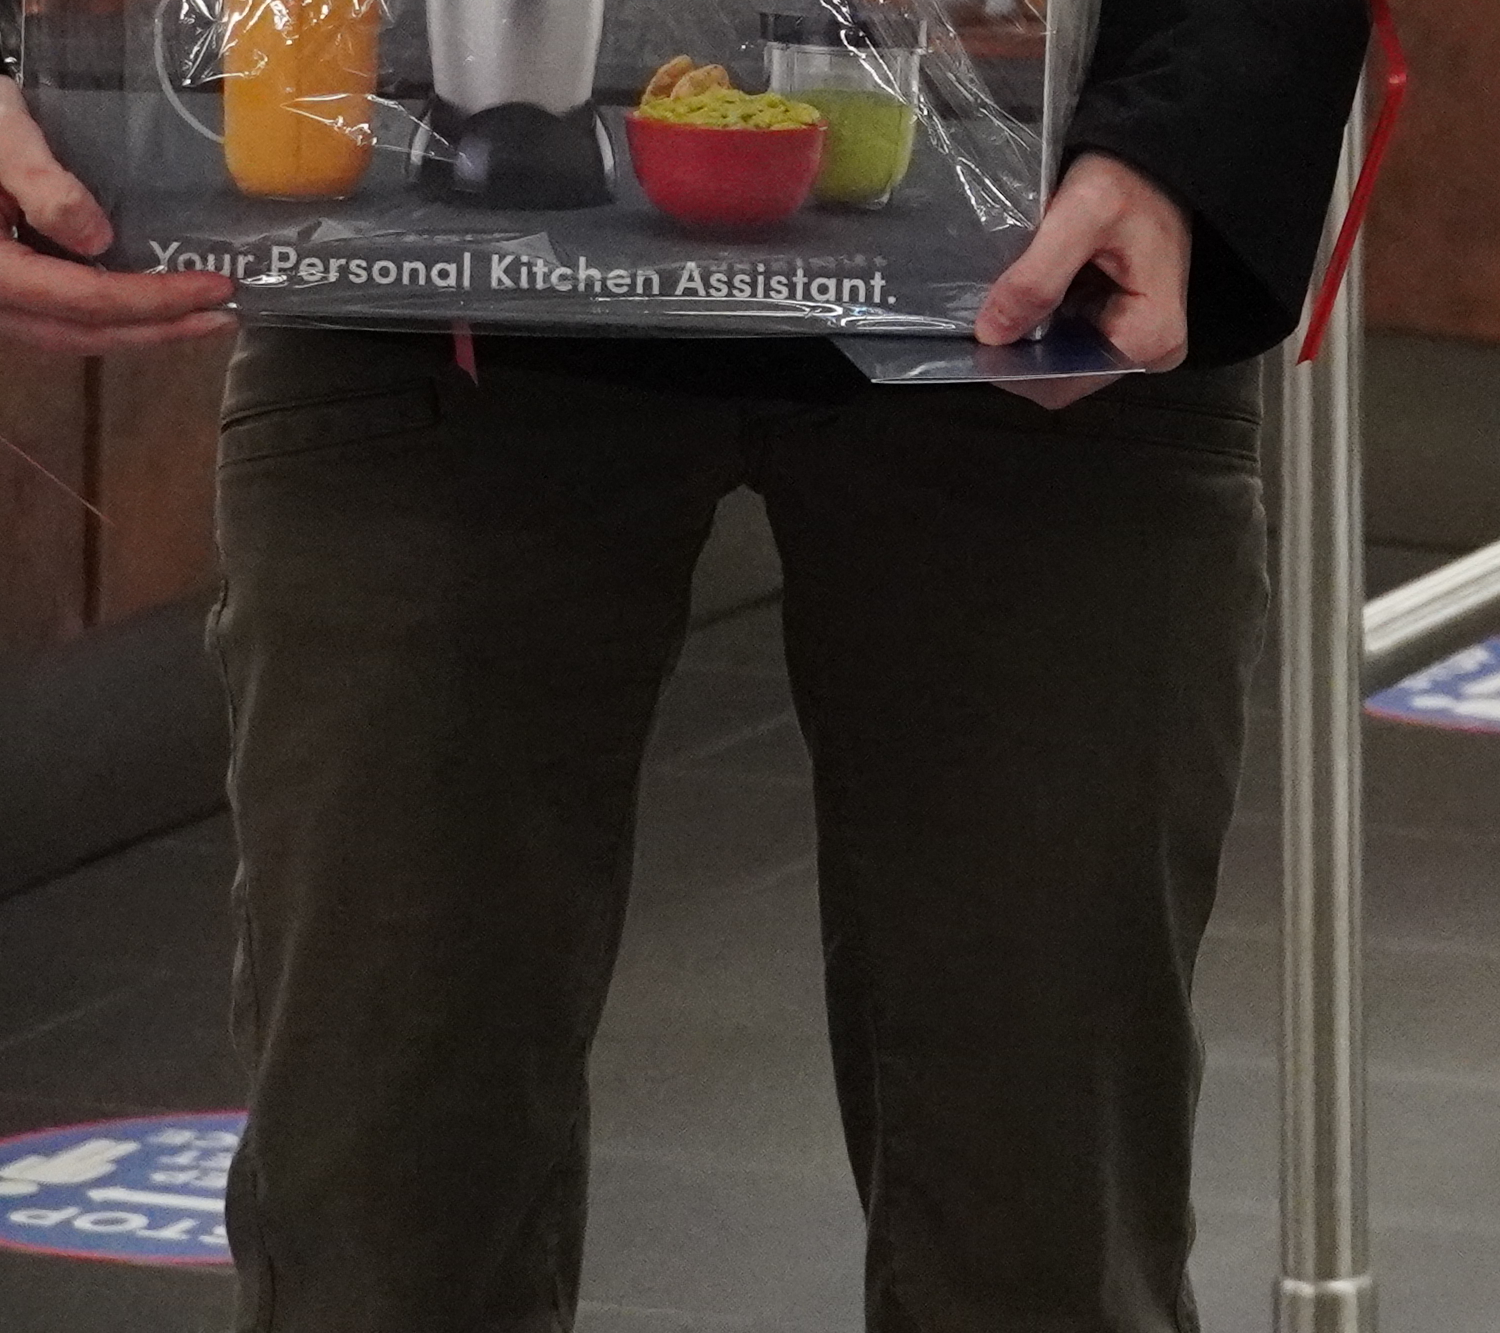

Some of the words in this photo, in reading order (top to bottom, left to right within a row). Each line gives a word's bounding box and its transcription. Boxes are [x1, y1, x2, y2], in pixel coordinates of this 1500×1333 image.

[149, 240, 254, 280] Your
[269, 243, 472, 291] Personal
[490, 245, 662, 297] Kitchen
[673, 258, 898, 307] Assistant.
